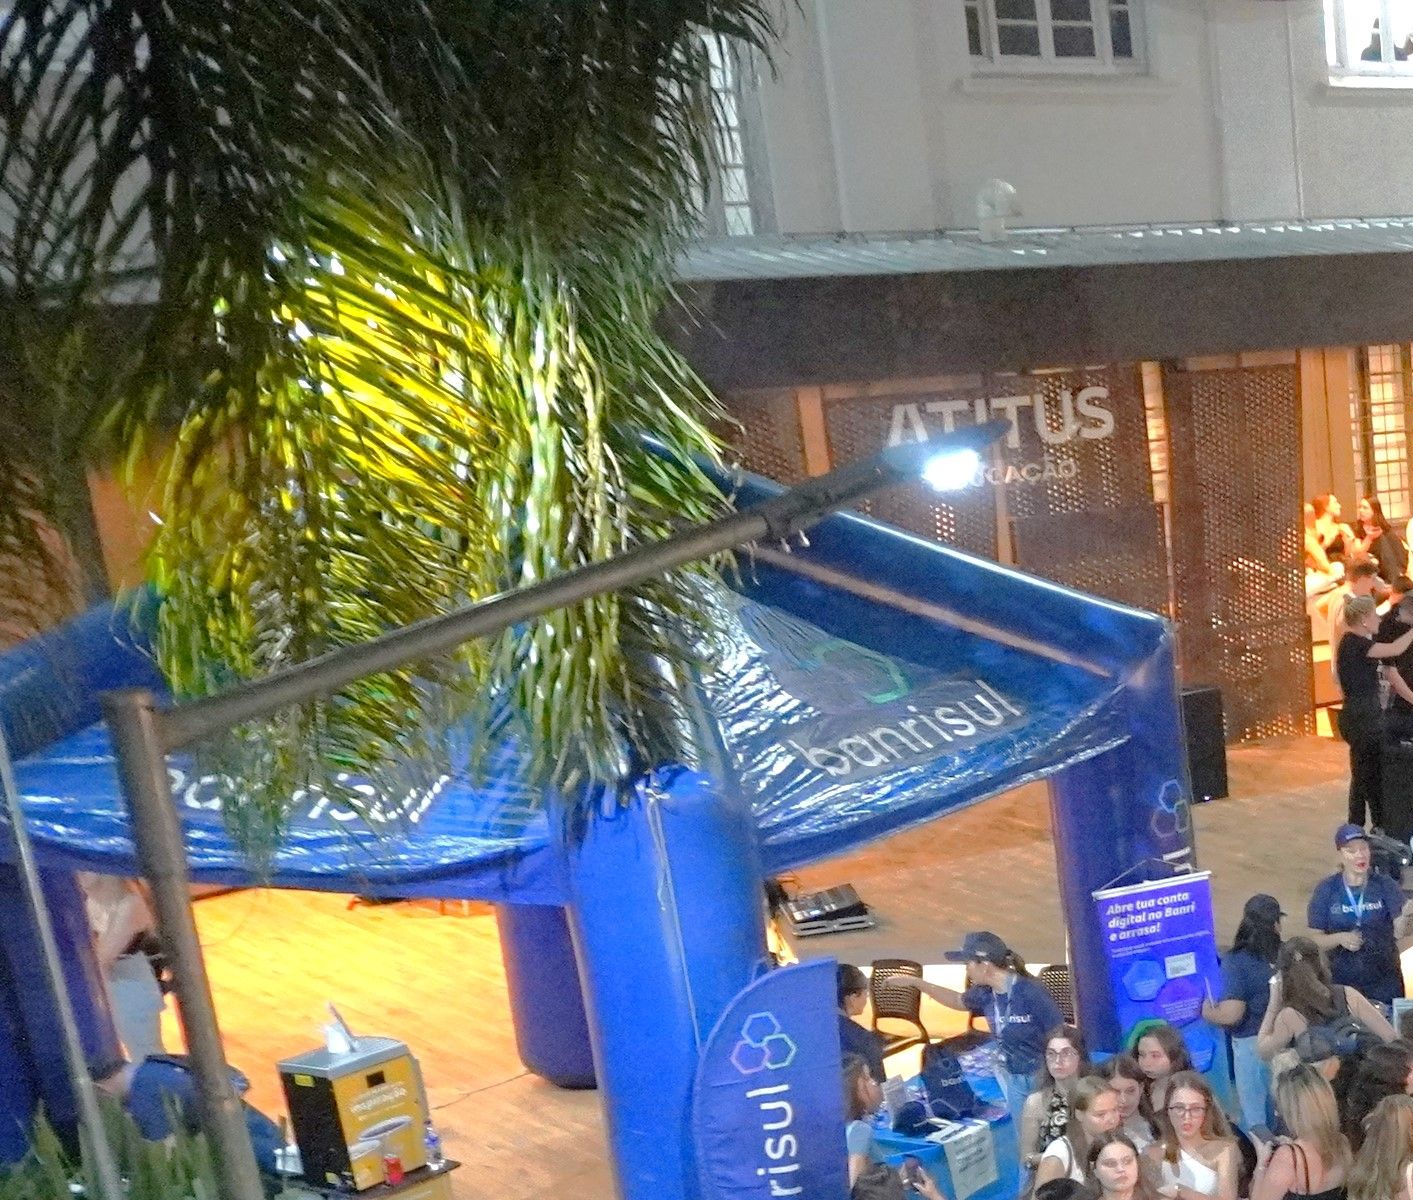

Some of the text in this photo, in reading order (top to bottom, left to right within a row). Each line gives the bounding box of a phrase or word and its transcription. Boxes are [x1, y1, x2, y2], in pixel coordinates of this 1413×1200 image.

[887, 386, 1114, 449] ATITUS
[788, 679, 1021, 776] banrisul
[1106, 892, 1189, 915] Abre tua conta
[1108, 901, 1196, 929] digital no Banri
[1109, 933, 1117, 942] e
[1119, 921, 1161, 940] arrasa!
